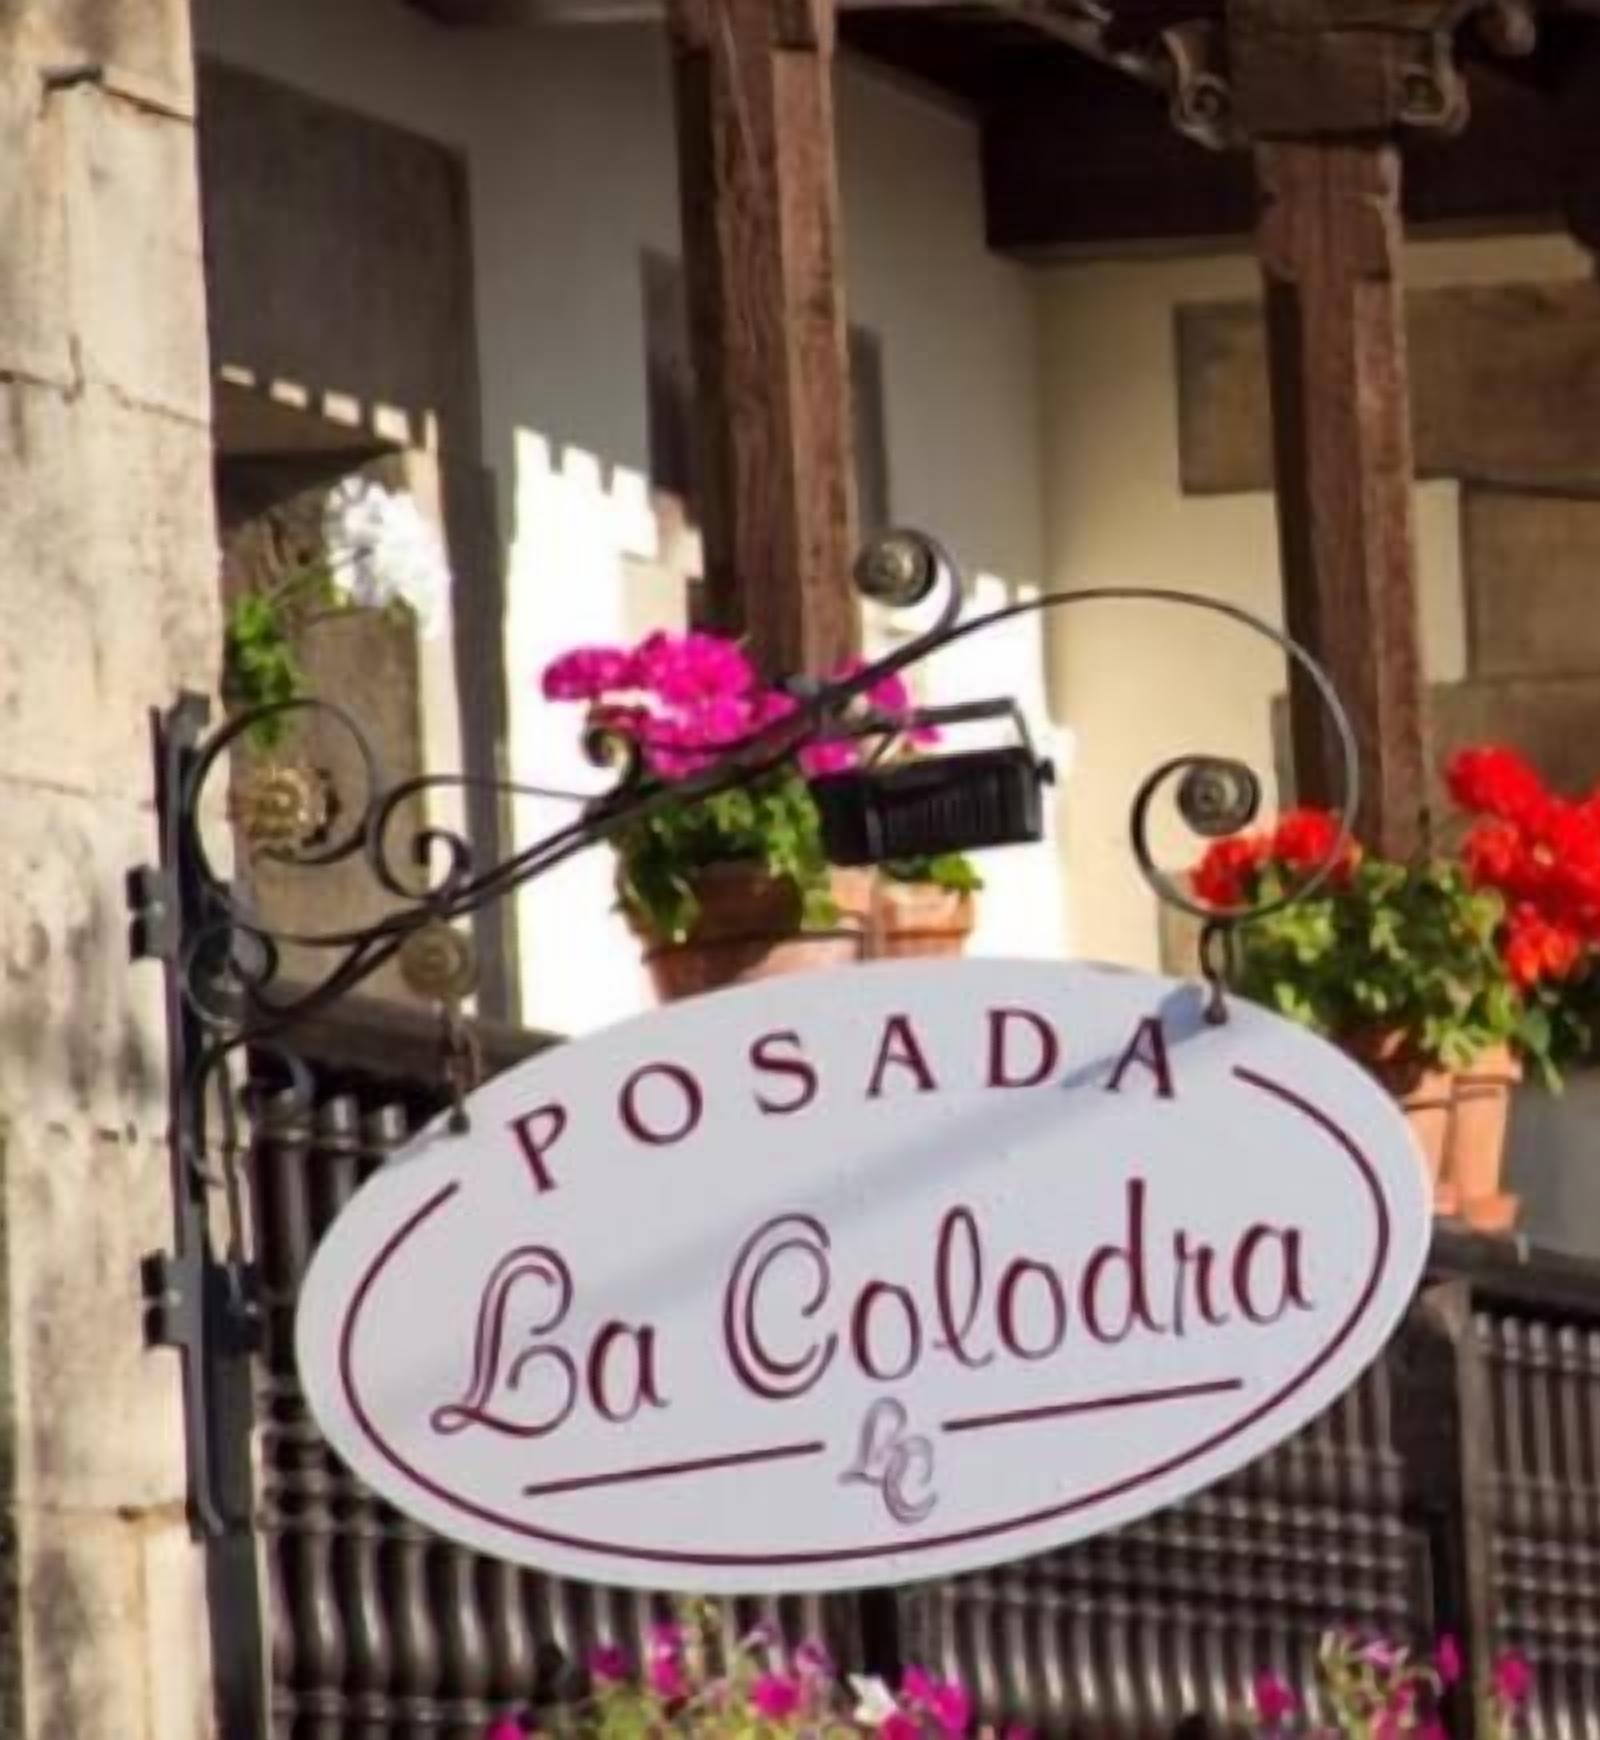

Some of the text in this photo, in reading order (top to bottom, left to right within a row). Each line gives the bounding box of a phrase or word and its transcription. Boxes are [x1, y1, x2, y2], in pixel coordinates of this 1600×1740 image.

[507, 1008, 1177, 1192] POSADA
[430, 1177, 1314, 1439] La Colodra
